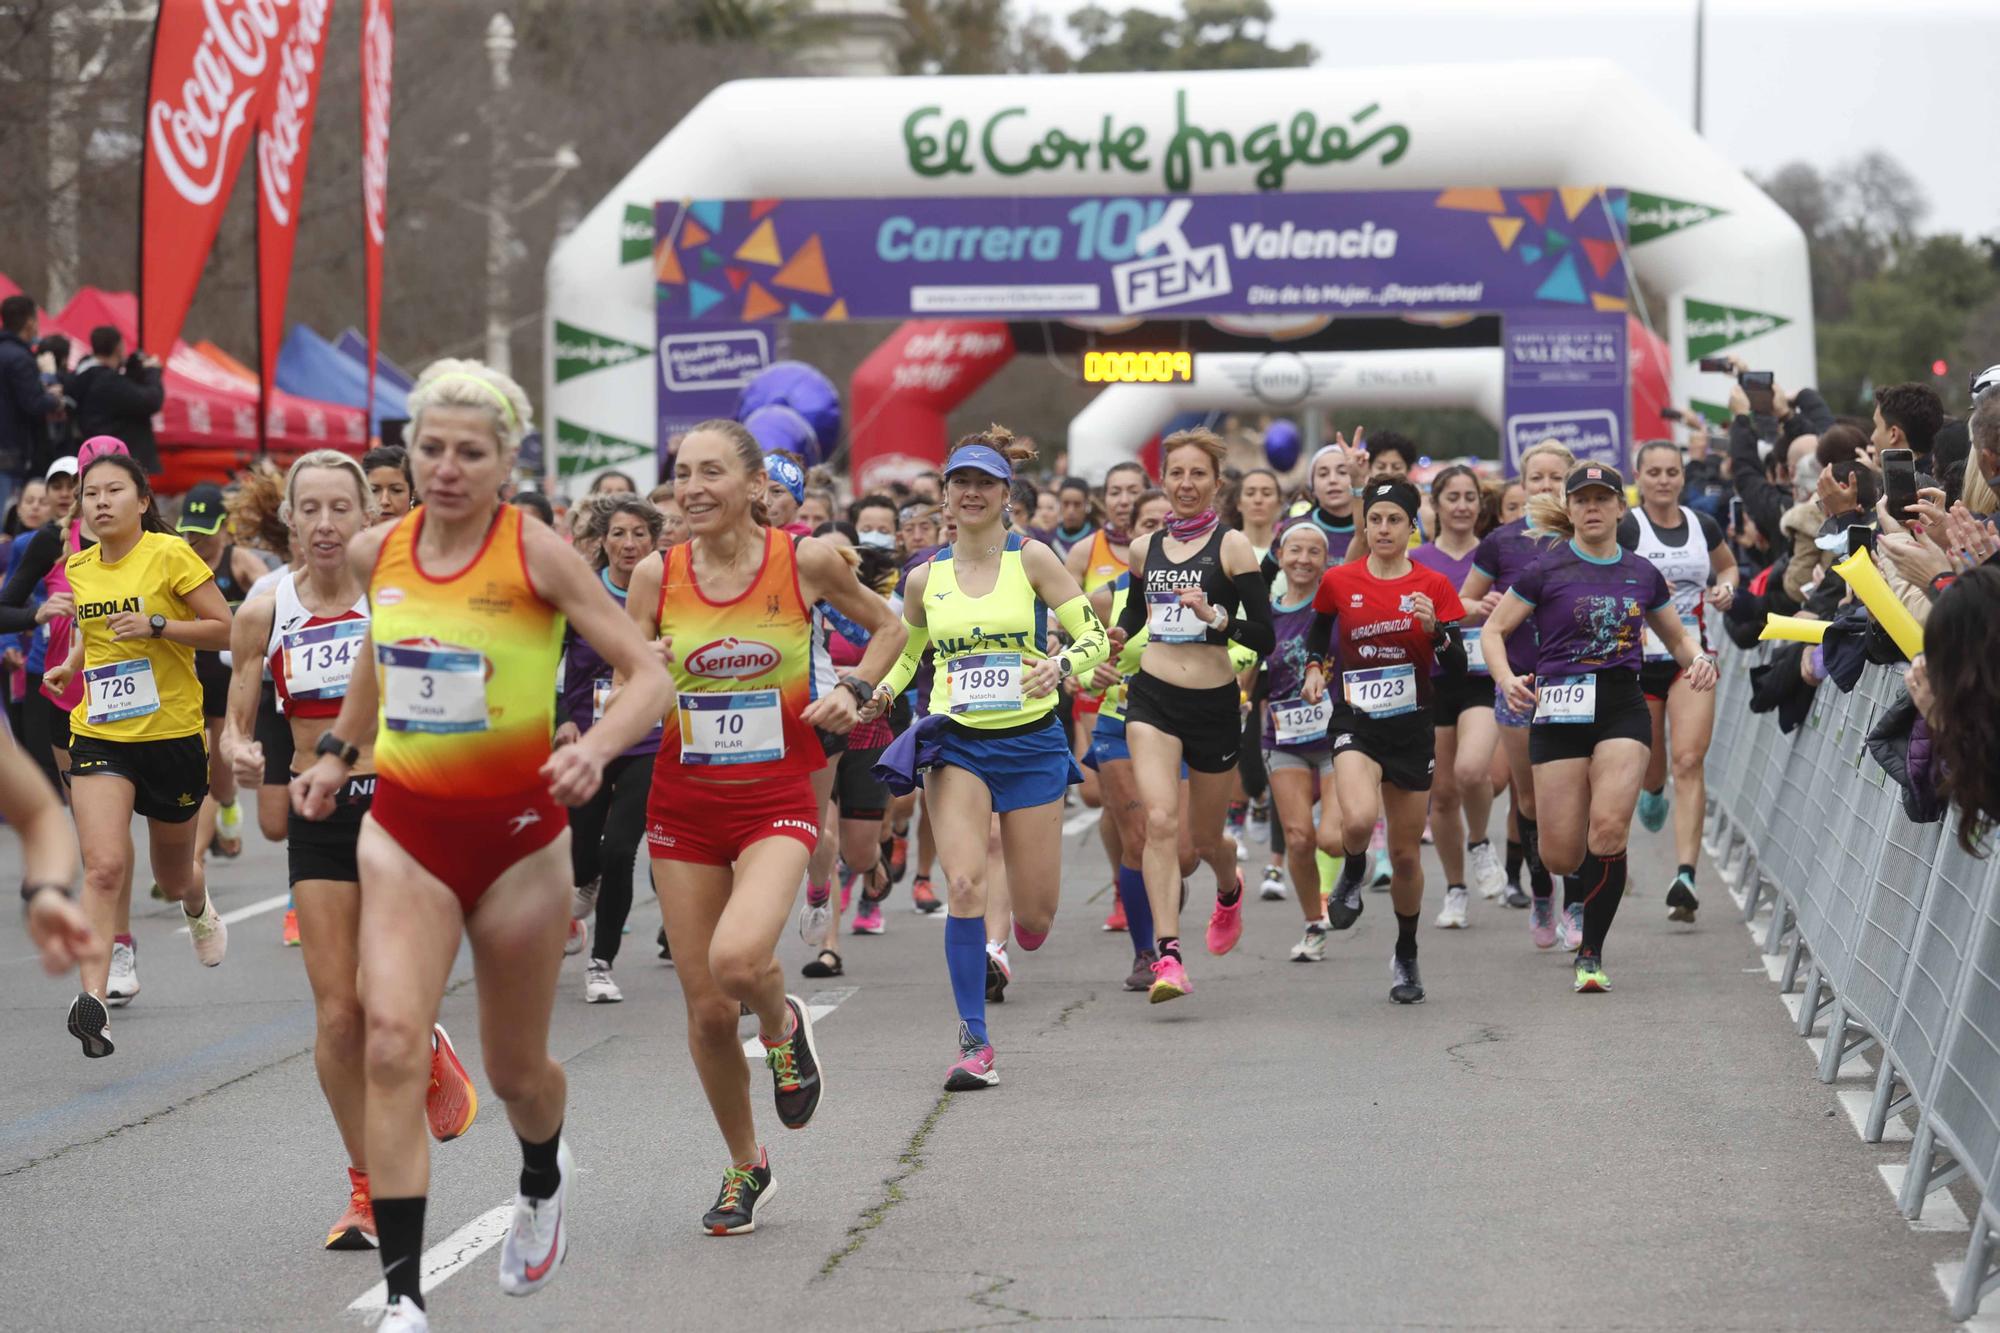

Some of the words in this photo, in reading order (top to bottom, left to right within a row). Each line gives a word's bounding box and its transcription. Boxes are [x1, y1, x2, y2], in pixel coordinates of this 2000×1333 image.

[904, 106, 974, 177] El
[982, 108, 1149, 176] Corte
[1152, 89, 1411, 191] Inglés
[876, 215, 1063, 262] Carrera
[1230, 221, 1398, 260] Valencia
[1126, 257, 1218, 306] FEM
[1147, 570, 1203, 582] VEGAN
[1164, 606, 1183, 622] 21
[690, 653, 774, 674] Serrano
[101, 676, 136, 700] 726
[420, 675, 435, 699] 3
[959, 668, 1010, 690] 1989
[1359, 679, 1405, 700] 1023
[969, 692, 996, 700] Natacha
[715, 714, 744, 735] 10
[1285, 705, 1324, 726] 1326
[714, 739, 743, 749] PILAR
[349, 778, 376, 796] NI
